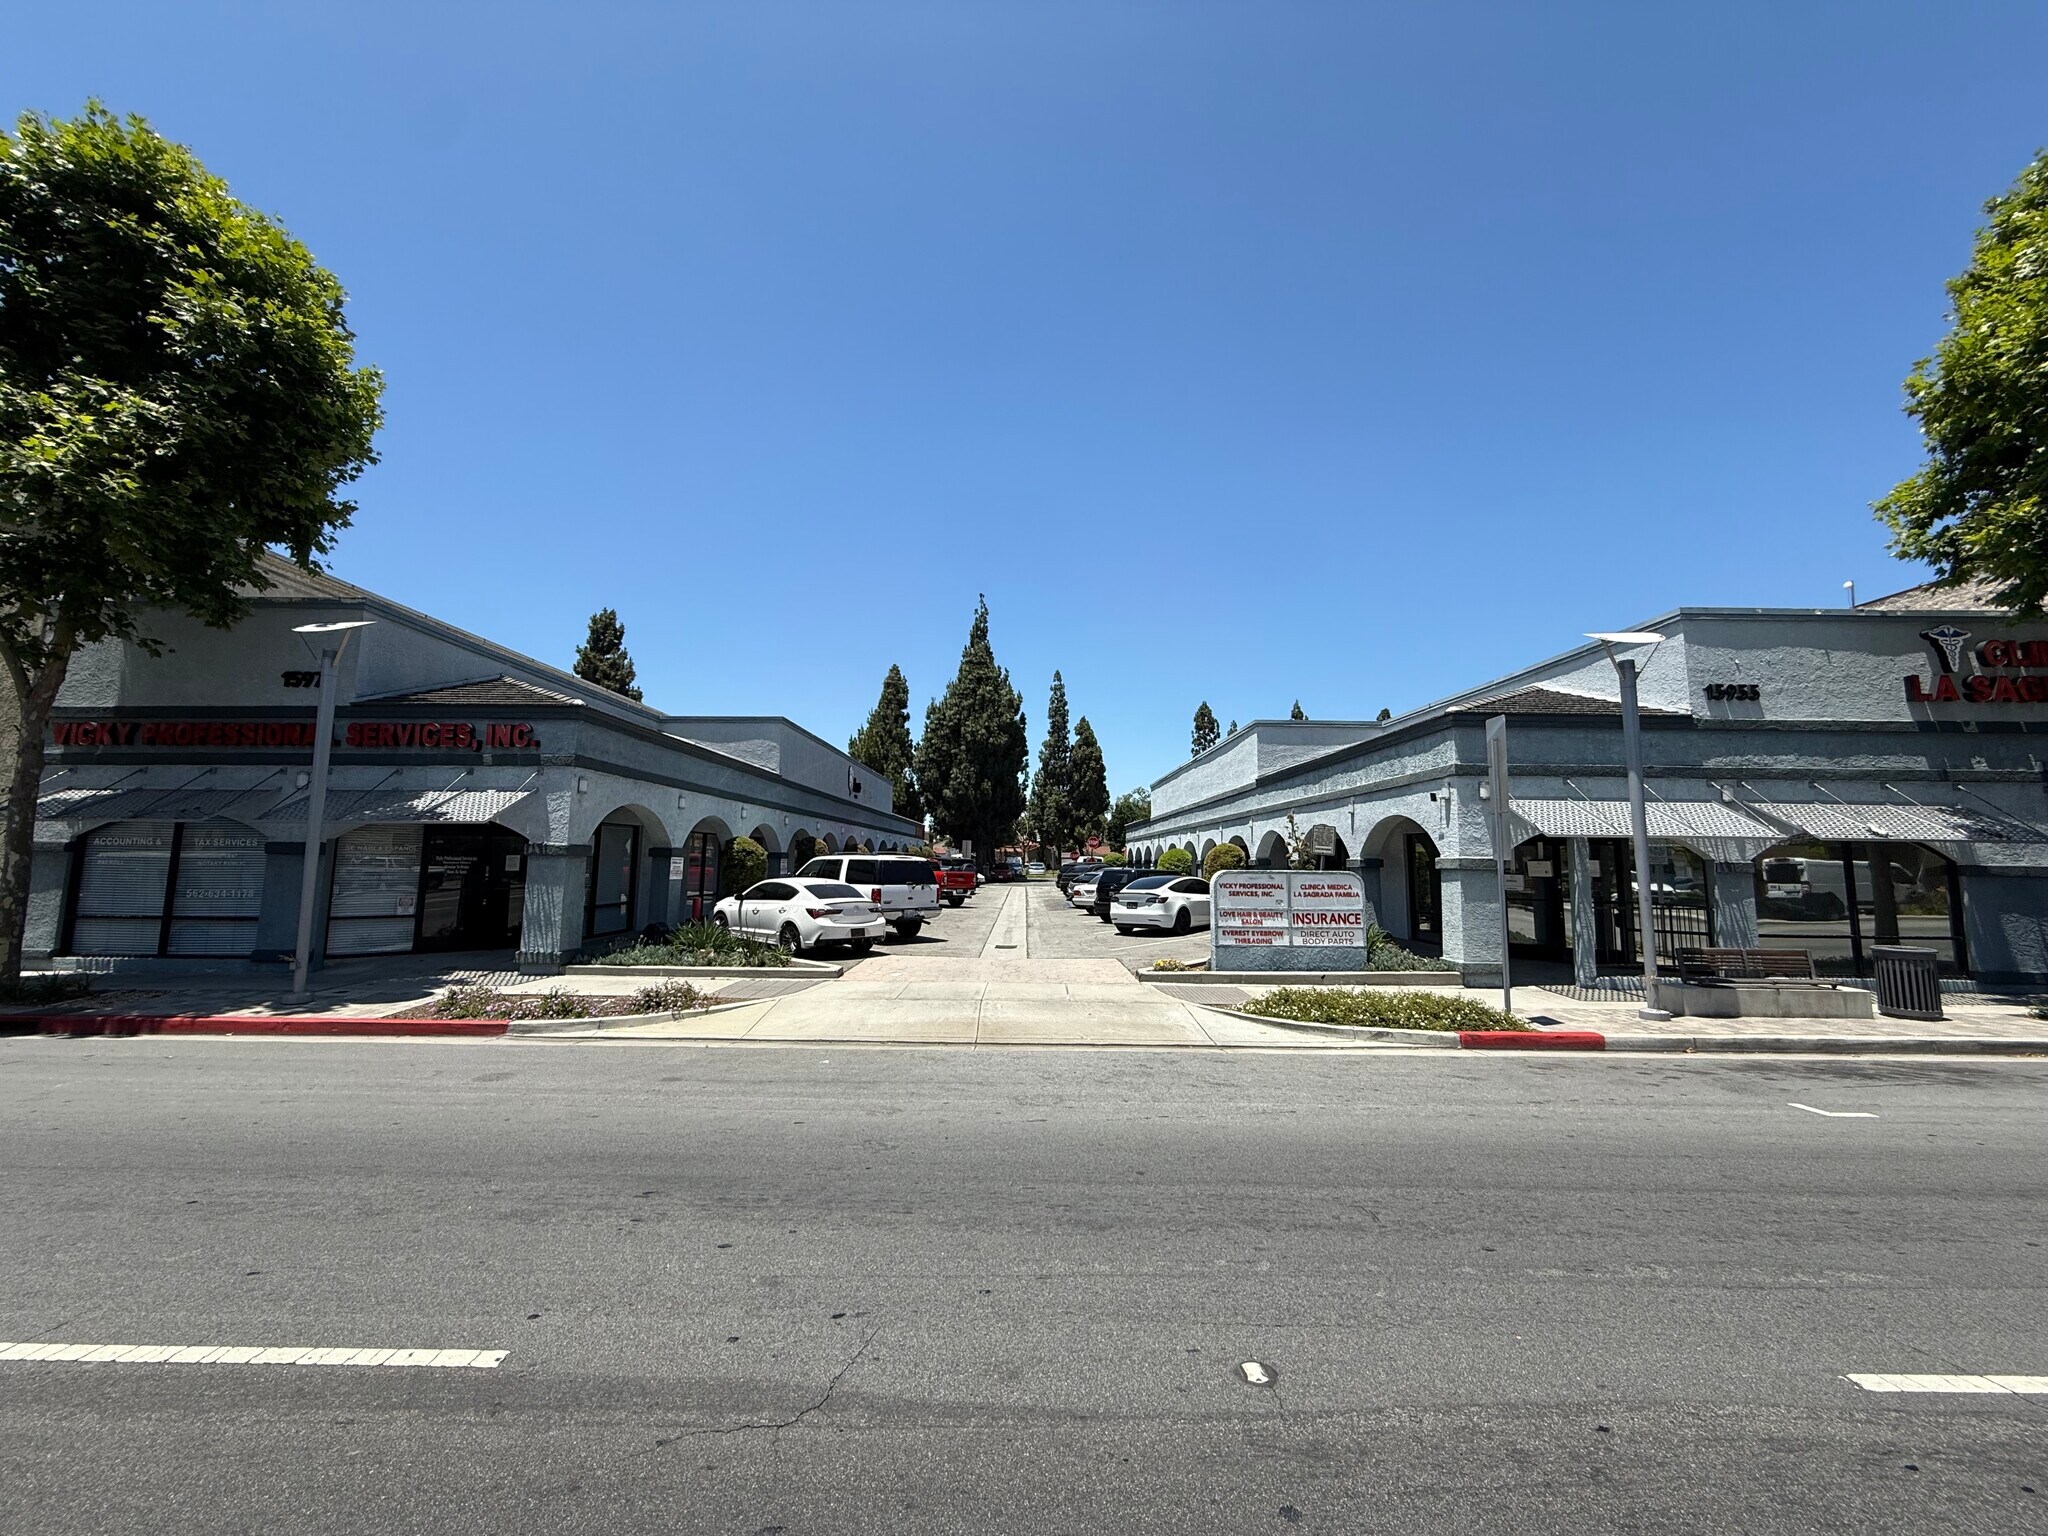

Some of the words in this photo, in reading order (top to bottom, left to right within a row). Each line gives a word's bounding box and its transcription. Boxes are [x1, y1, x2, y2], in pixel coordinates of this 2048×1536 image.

[281, 671, 321, 687] 1597
[1702, 683, 1761, 701] 15955
[1903, 674, 1960, 702] LA
[1962, 675, 2048, 703] SAG
[53, 722, 136, 745] VICKY
[141, 722, 341, 745] PROFESSIONA
[345, 722, 482, 751] SERVICES,
[486, 722, 541, 747] INC.
[94, 837, 153, 846] ACCOUNTING
[155, 837, 162, 846] &
[194, 838, 211, 846] TAX
[213, 838, 258, 847] SERVICES
[1292, 912, 1362, 925] INSURANCE
